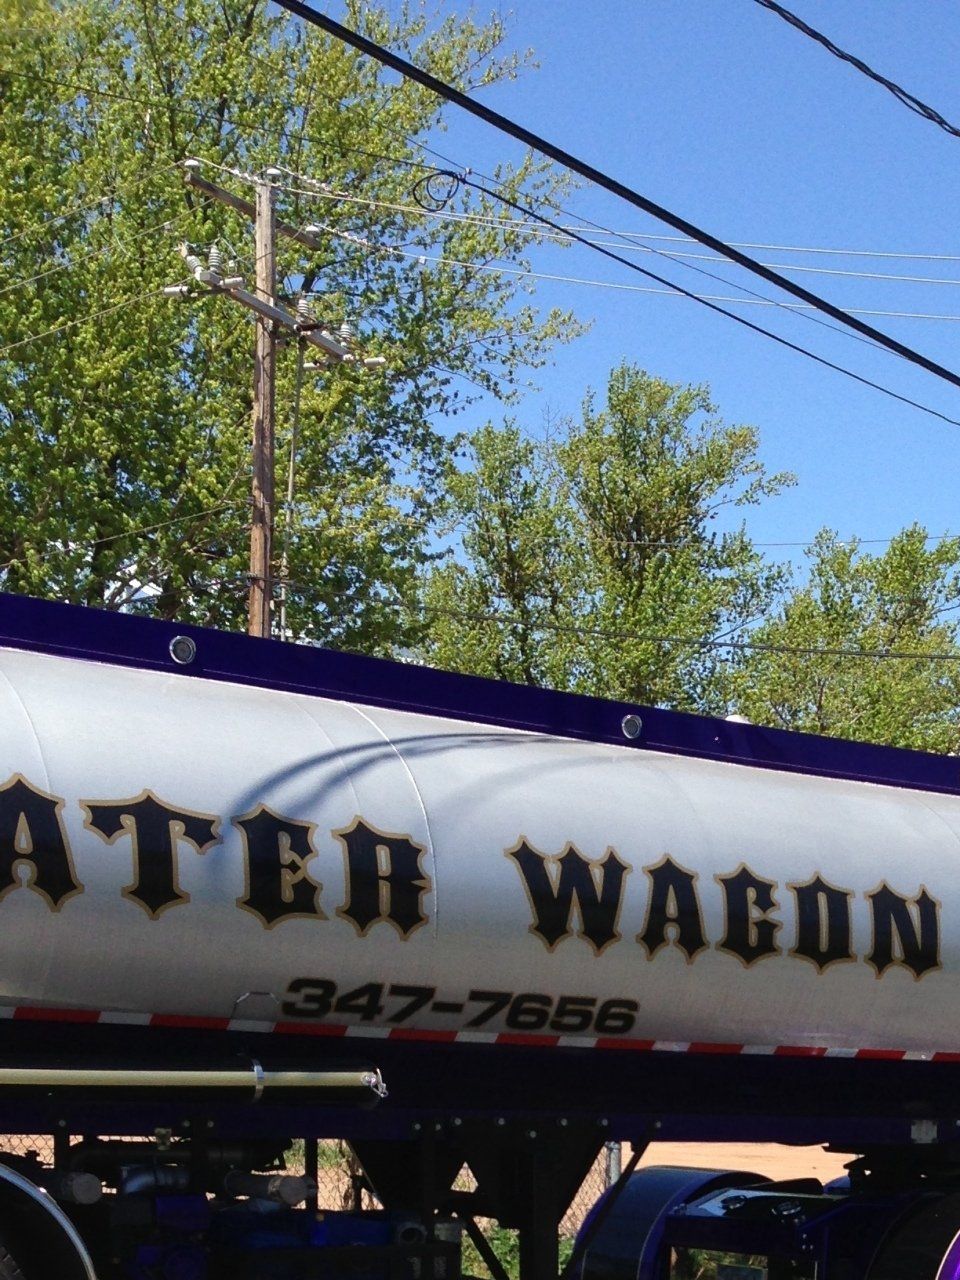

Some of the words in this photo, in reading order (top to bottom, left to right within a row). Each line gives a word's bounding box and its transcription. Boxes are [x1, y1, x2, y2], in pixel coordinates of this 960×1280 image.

[0, 772, 432, 941] ATER
[503, 834, 943, 982] WAGON
[282, 978, 640, 1034] 347-7656
